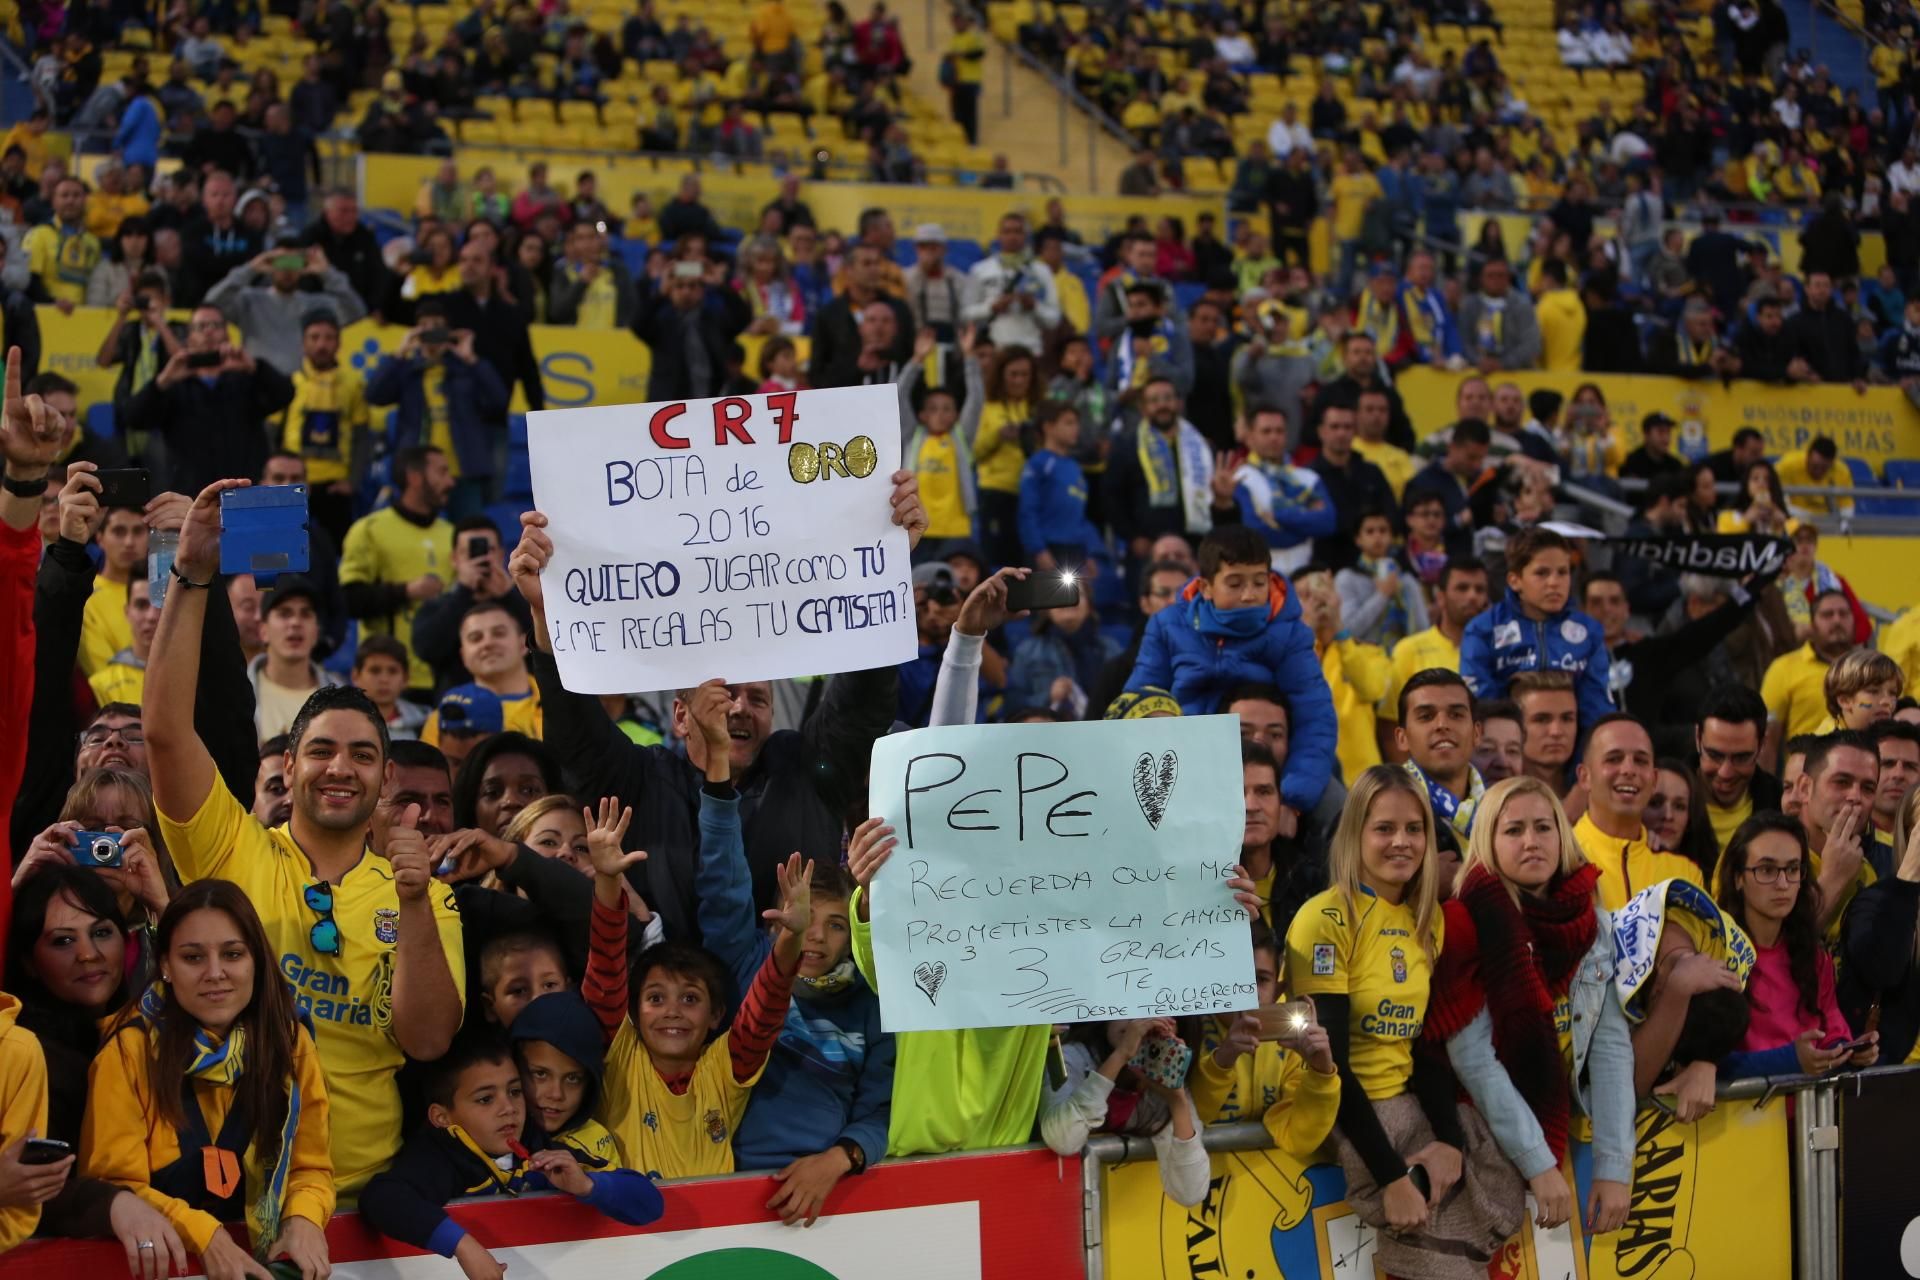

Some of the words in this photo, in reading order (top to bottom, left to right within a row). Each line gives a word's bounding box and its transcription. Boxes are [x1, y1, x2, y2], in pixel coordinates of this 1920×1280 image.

[648, 391, 800, 450] CR7
[605, 454, 707, 507] BOTA
[725, 462, 764, 494] de
[787, 434, 878, 485] ORO
[677, 504, 771, 546] 2016
[564, 560, 681, 607] QUIERO
[694, 552, 782, 594] JUGAR
[853, 539, 885, 579] TÚ
[622, 606, 732, 650] REGALAS
[746, 600, 788, 638] TU
[908, 858, 1093, 907] RECUERDA
[1111, 864, 1177, 884] QUE
[1199, 860, 1235, 882] ME
[1108, 913, 1142, 930] LA
[279, 952, 351, 997] Gran
[999, 947, 1050, 997] 3
[1106, 968, 1153, 993] TE
[1076, 1003, 1128, 1020] DESDE
[1377, 998, 1415, 1020] Gran
